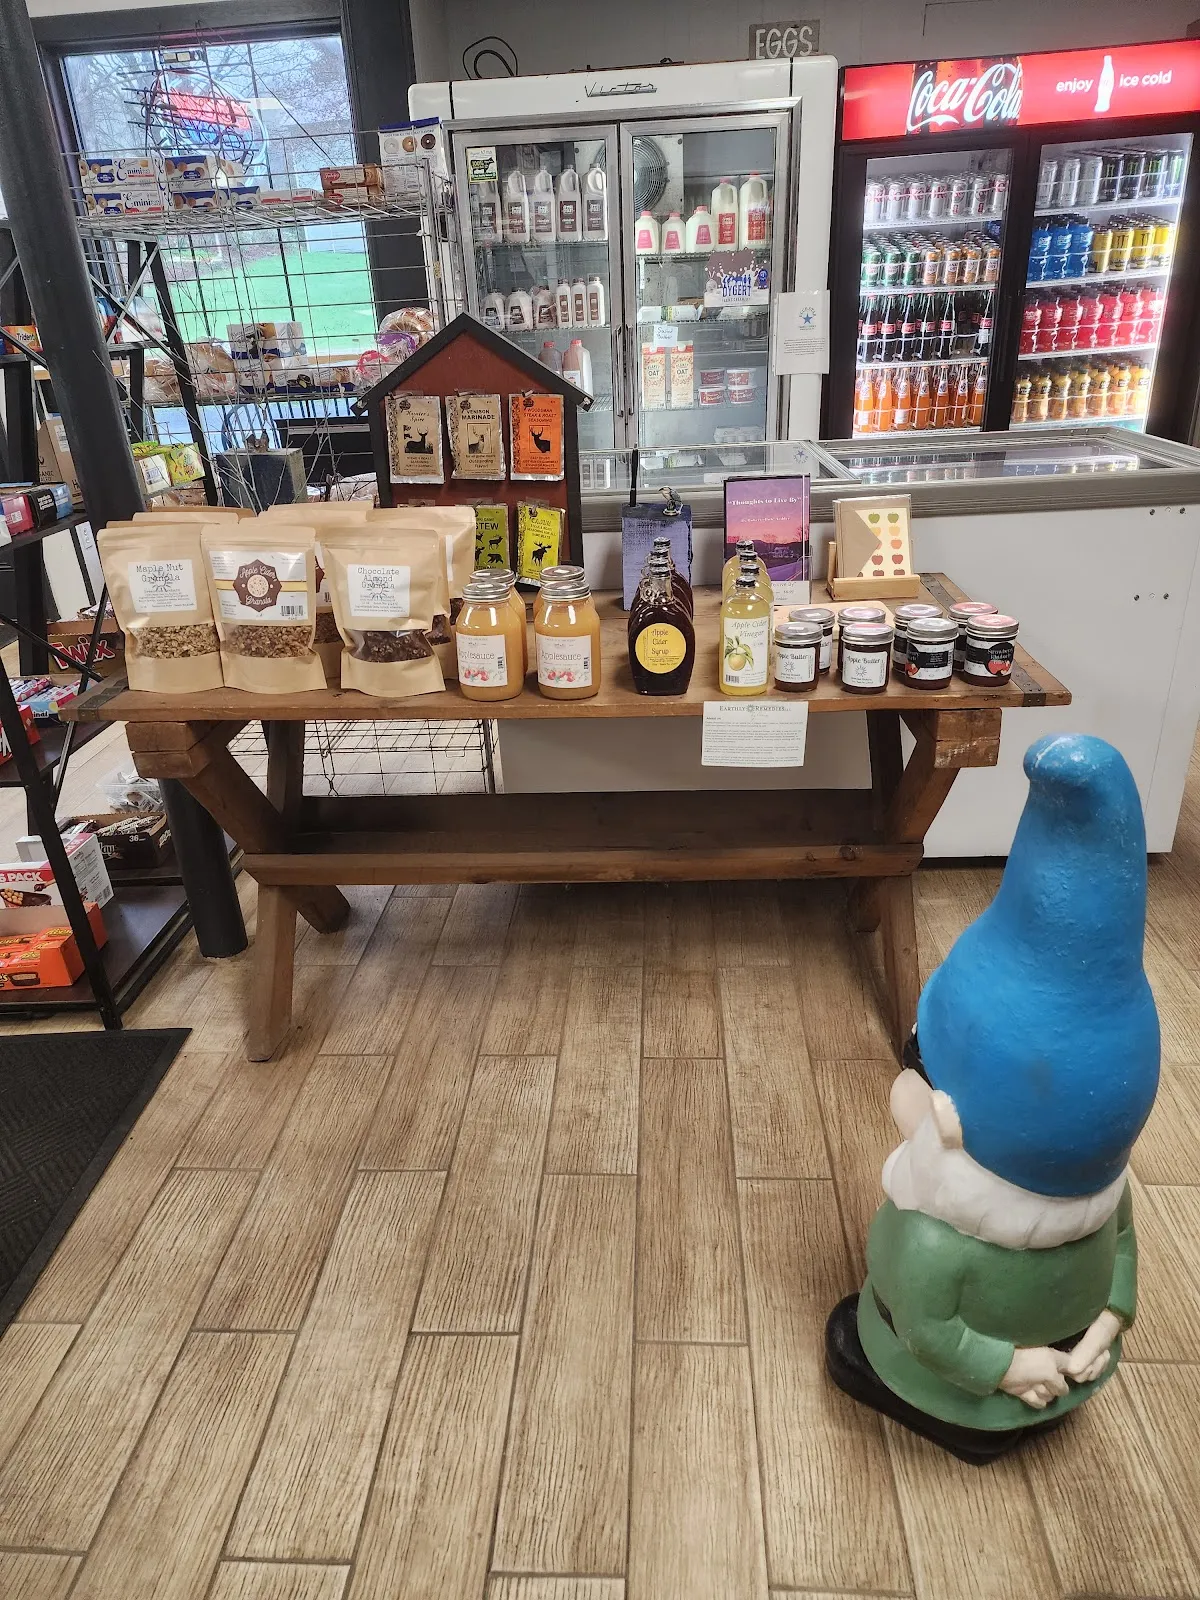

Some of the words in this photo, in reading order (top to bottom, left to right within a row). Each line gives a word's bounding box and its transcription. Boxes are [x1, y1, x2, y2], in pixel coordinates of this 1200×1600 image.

[755, 25, 813, 60] EGGS
[1119, 73, 1139, 88] ice
[1141, 70, 1172, 86] cold
[1056, 78, 1094, 96] enjoy
[906, 62, 1024, 132] Coca-Cola
[722, 285, 751, 298] DYGERT
[136, 564, 164, 575] Maple
[166, 563, 184, 571] Nut
[239, 566, 259, 579] Apple
[357, 567, 400, 576] Chocolate
[141, 573, 181, 583] Granola
[363, 574, 393, 582] Almond
[361, 581, 395, 589] Granola
[245, 594, 273, 606] Granola
[731, 621, 751, 630] Apple
[751, 619, 767, 628] Cider
[739, 630, 764, 639] Vinegar
[33, 711, 50, 719] inal
[129, 834, 139, 843] 36
[7, 871, 43, 882] PACK
